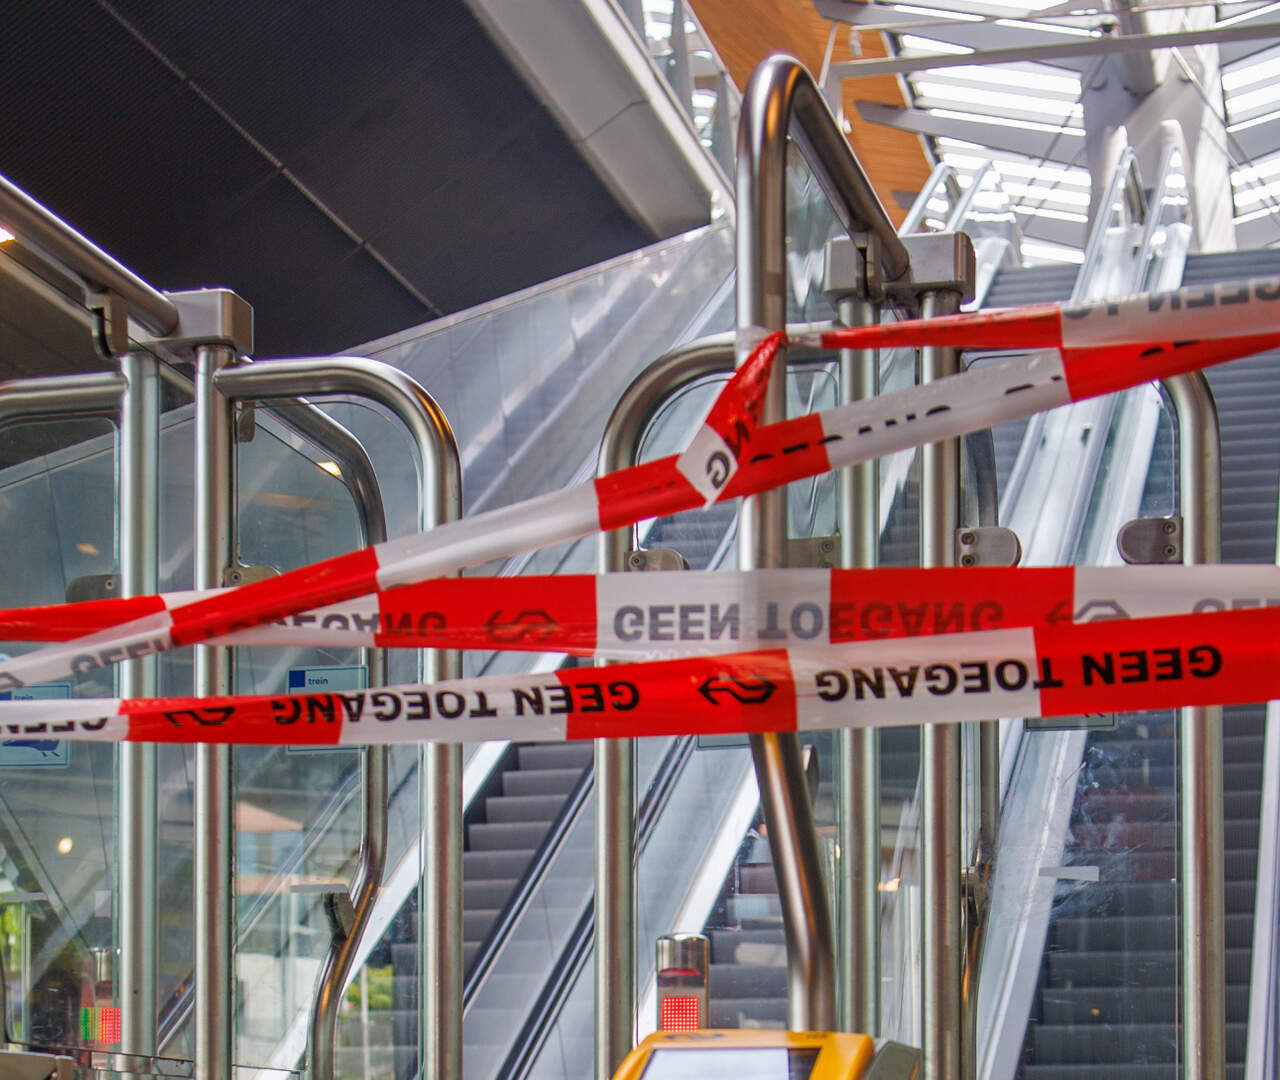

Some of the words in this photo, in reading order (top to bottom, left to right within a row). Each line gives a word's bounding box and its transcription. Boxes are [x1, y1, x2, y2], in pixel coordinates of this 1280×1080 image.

[308, 676, 329, 686] trein
[815, 658, 1062, 703] TOEGANG
[1082, 644, 1223, 686] GEEN
[271, 690, 497, 725] TOEGANG
[510, 681, 641, 717] GEEN
